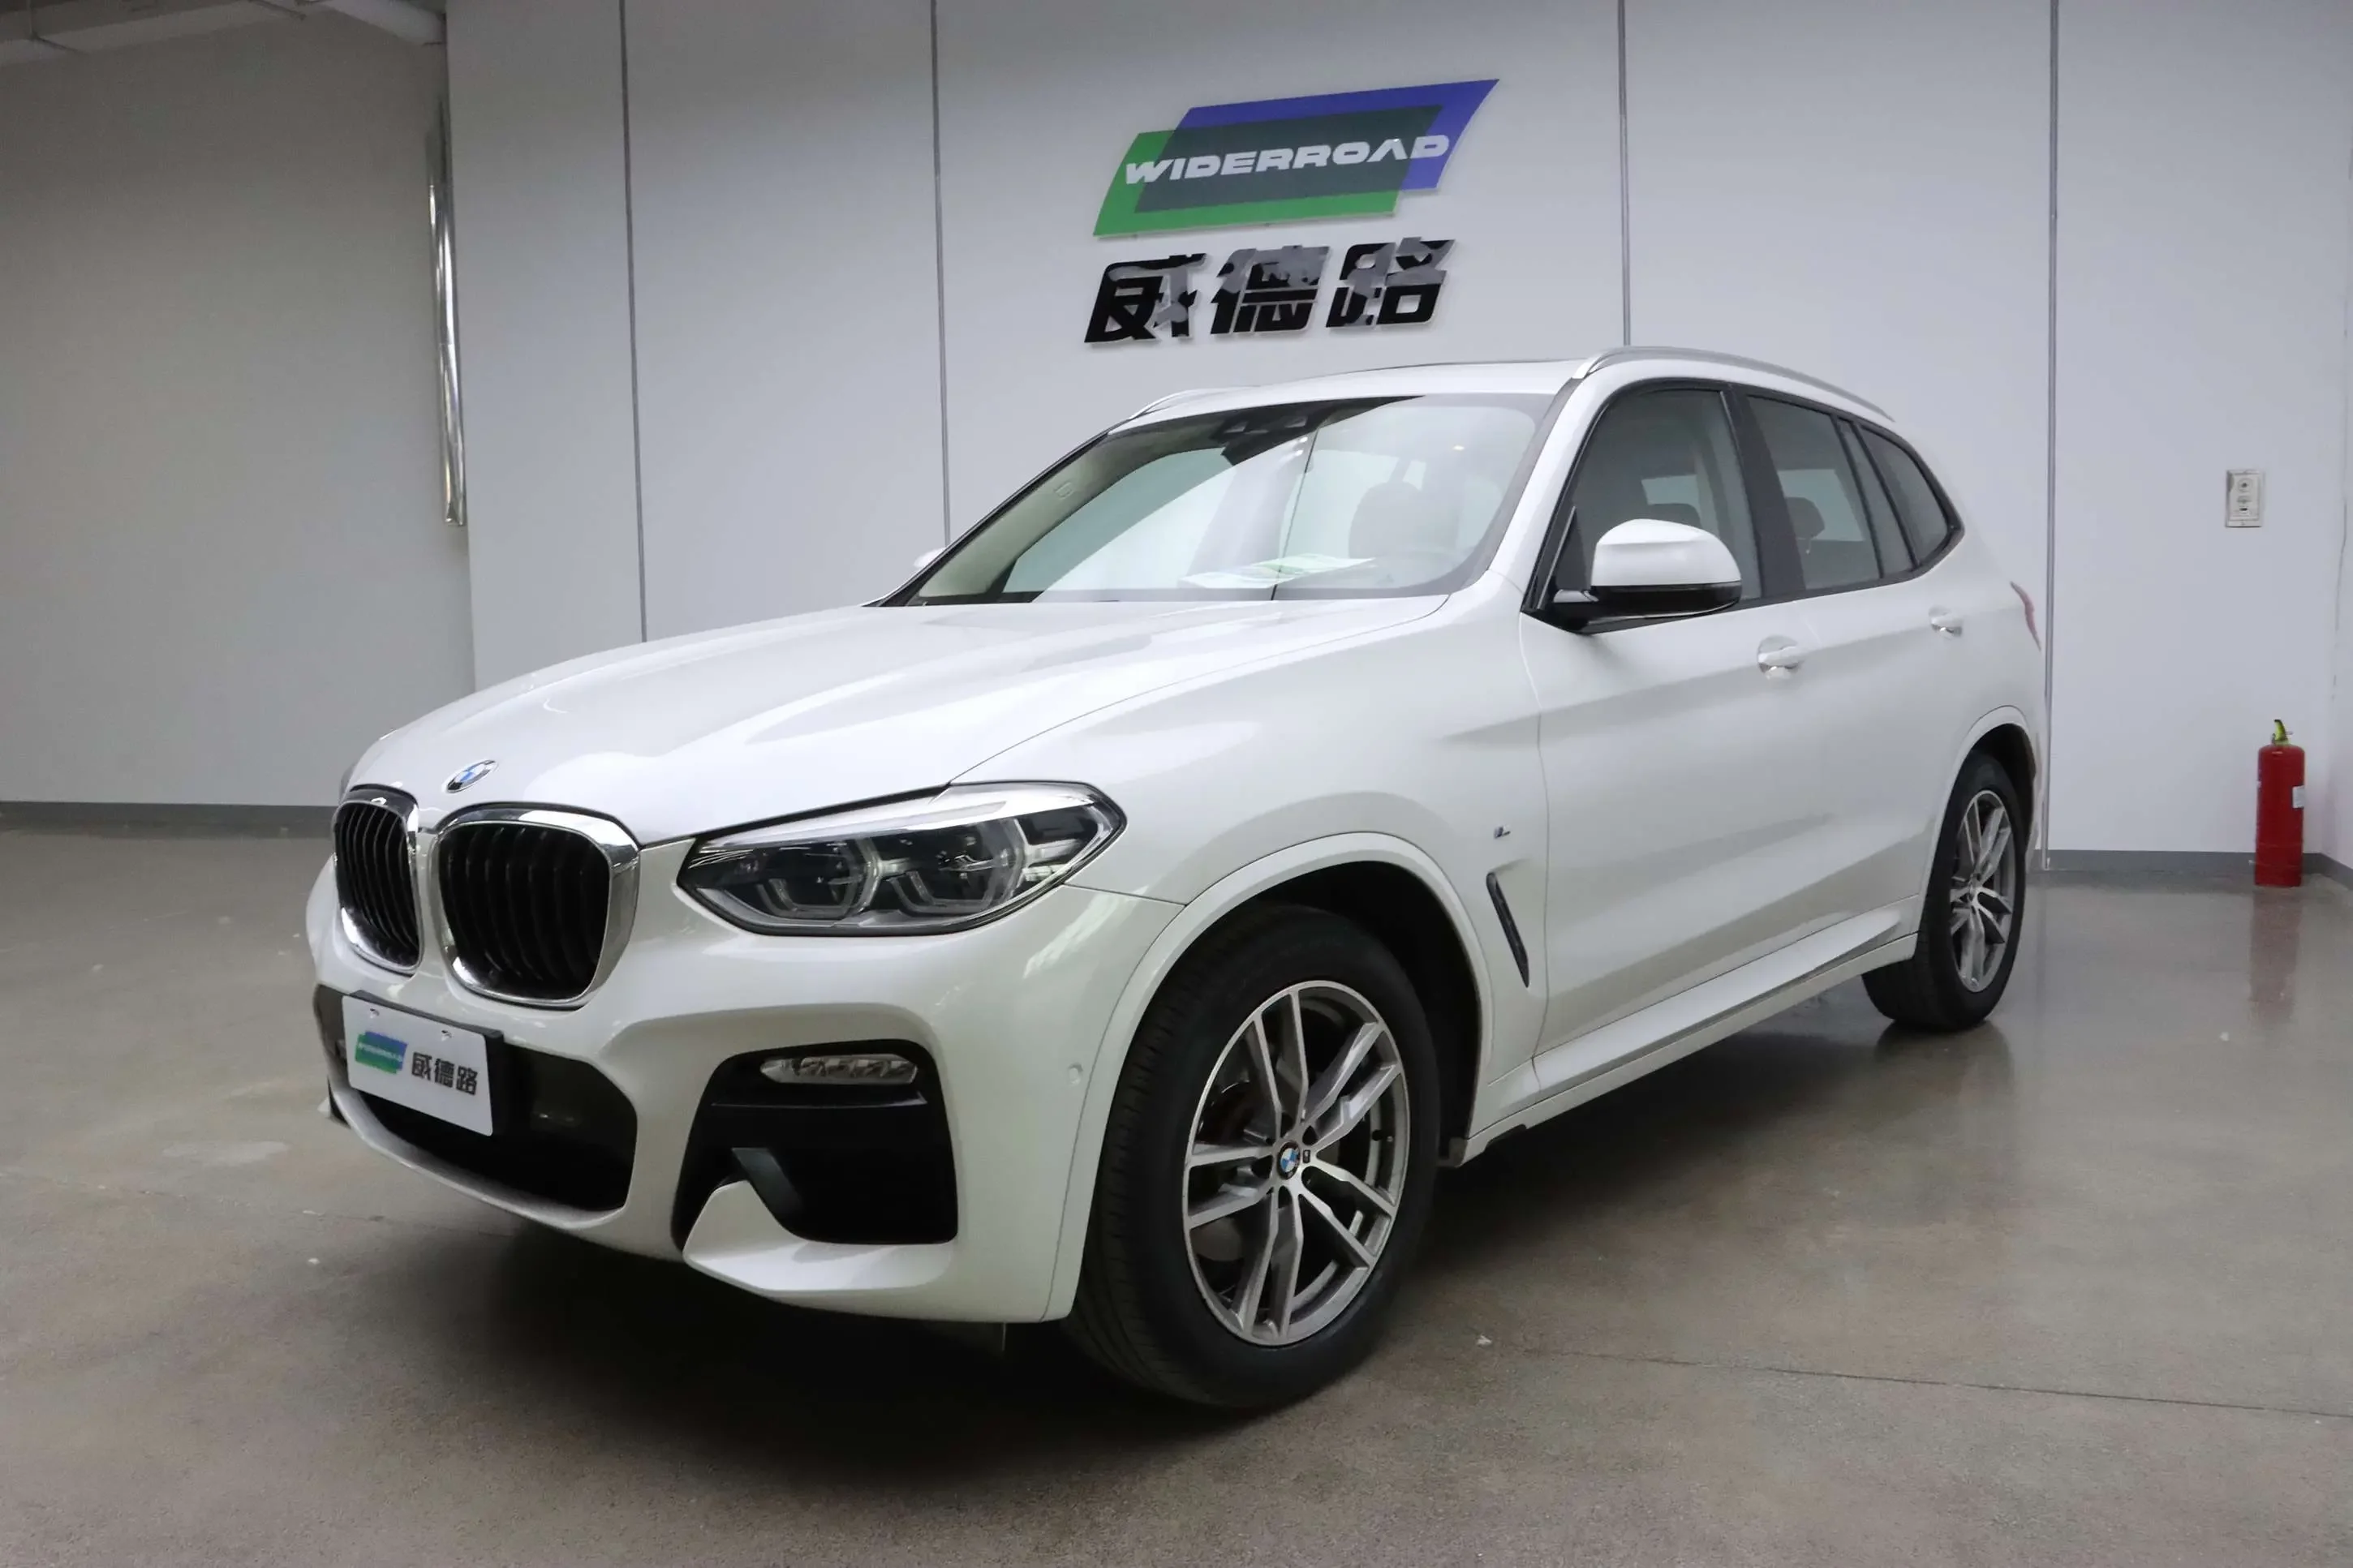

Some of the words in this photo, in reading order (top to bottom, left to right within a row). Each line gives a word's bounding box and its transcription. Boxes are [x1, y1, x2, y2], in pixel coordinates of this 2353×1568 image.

[1125, 135, 1450, 185] WIDERROAD
[1084, 237, 1456, 343] 威德路
[411, 1051, 478, 1096] 威德路
